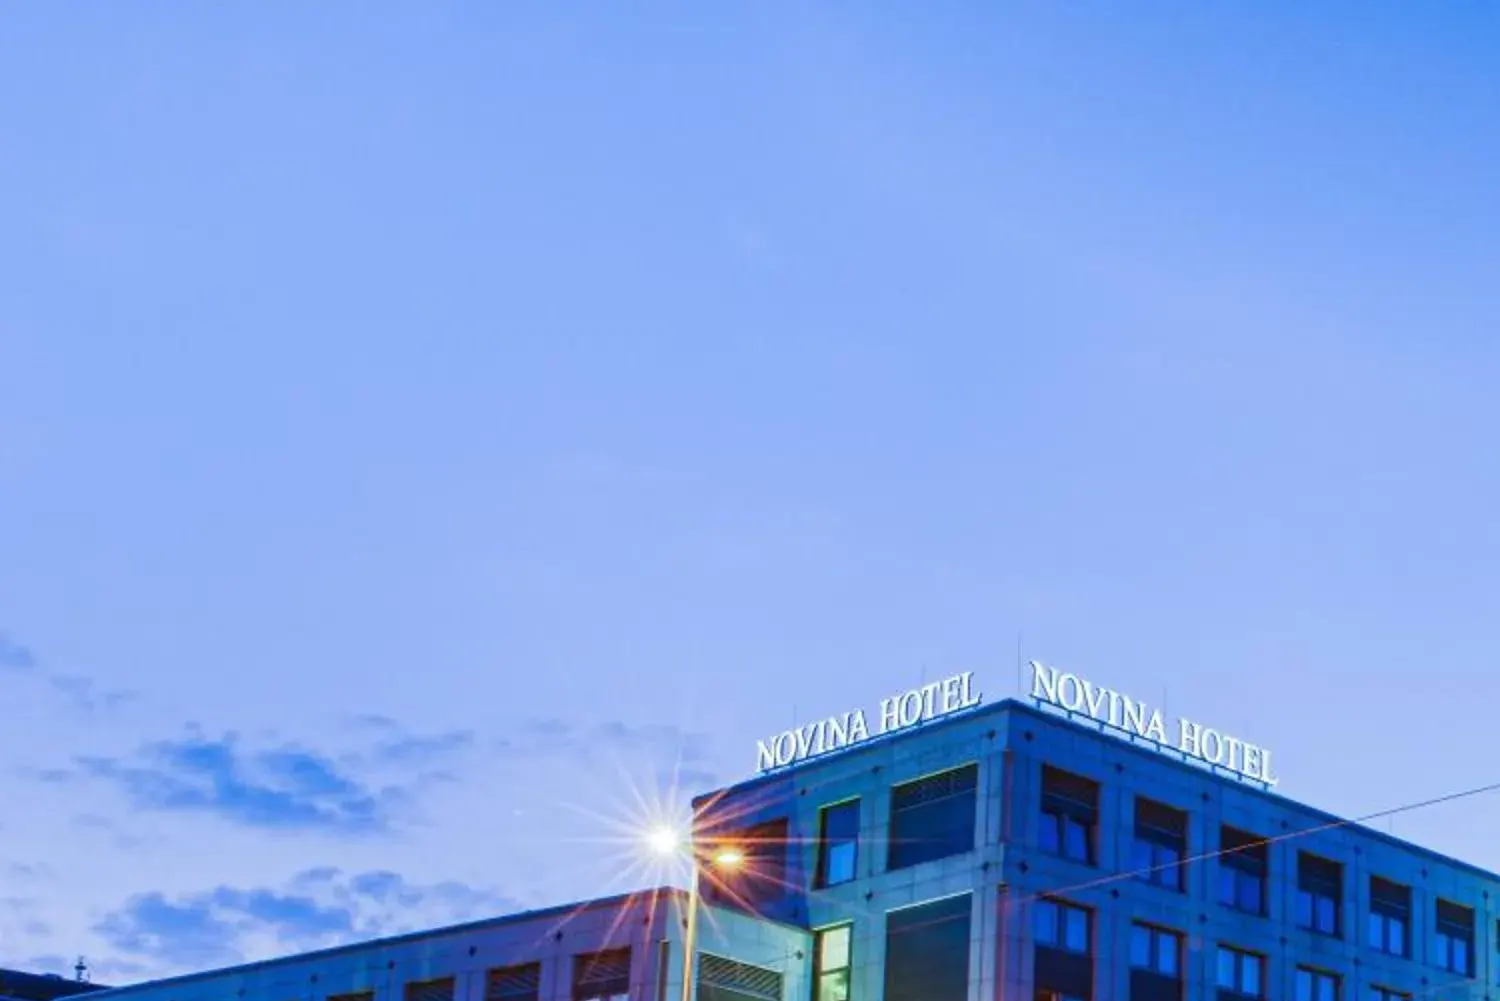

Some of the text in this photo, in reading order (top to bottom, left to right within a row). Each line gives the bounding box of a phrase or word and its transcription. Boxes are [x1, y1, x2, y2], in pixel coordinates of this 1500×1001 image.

[756, 671, 983, 772] NOVINA HOTEL
[1030, 661, 1279, 786] NOVINA HOTEL
